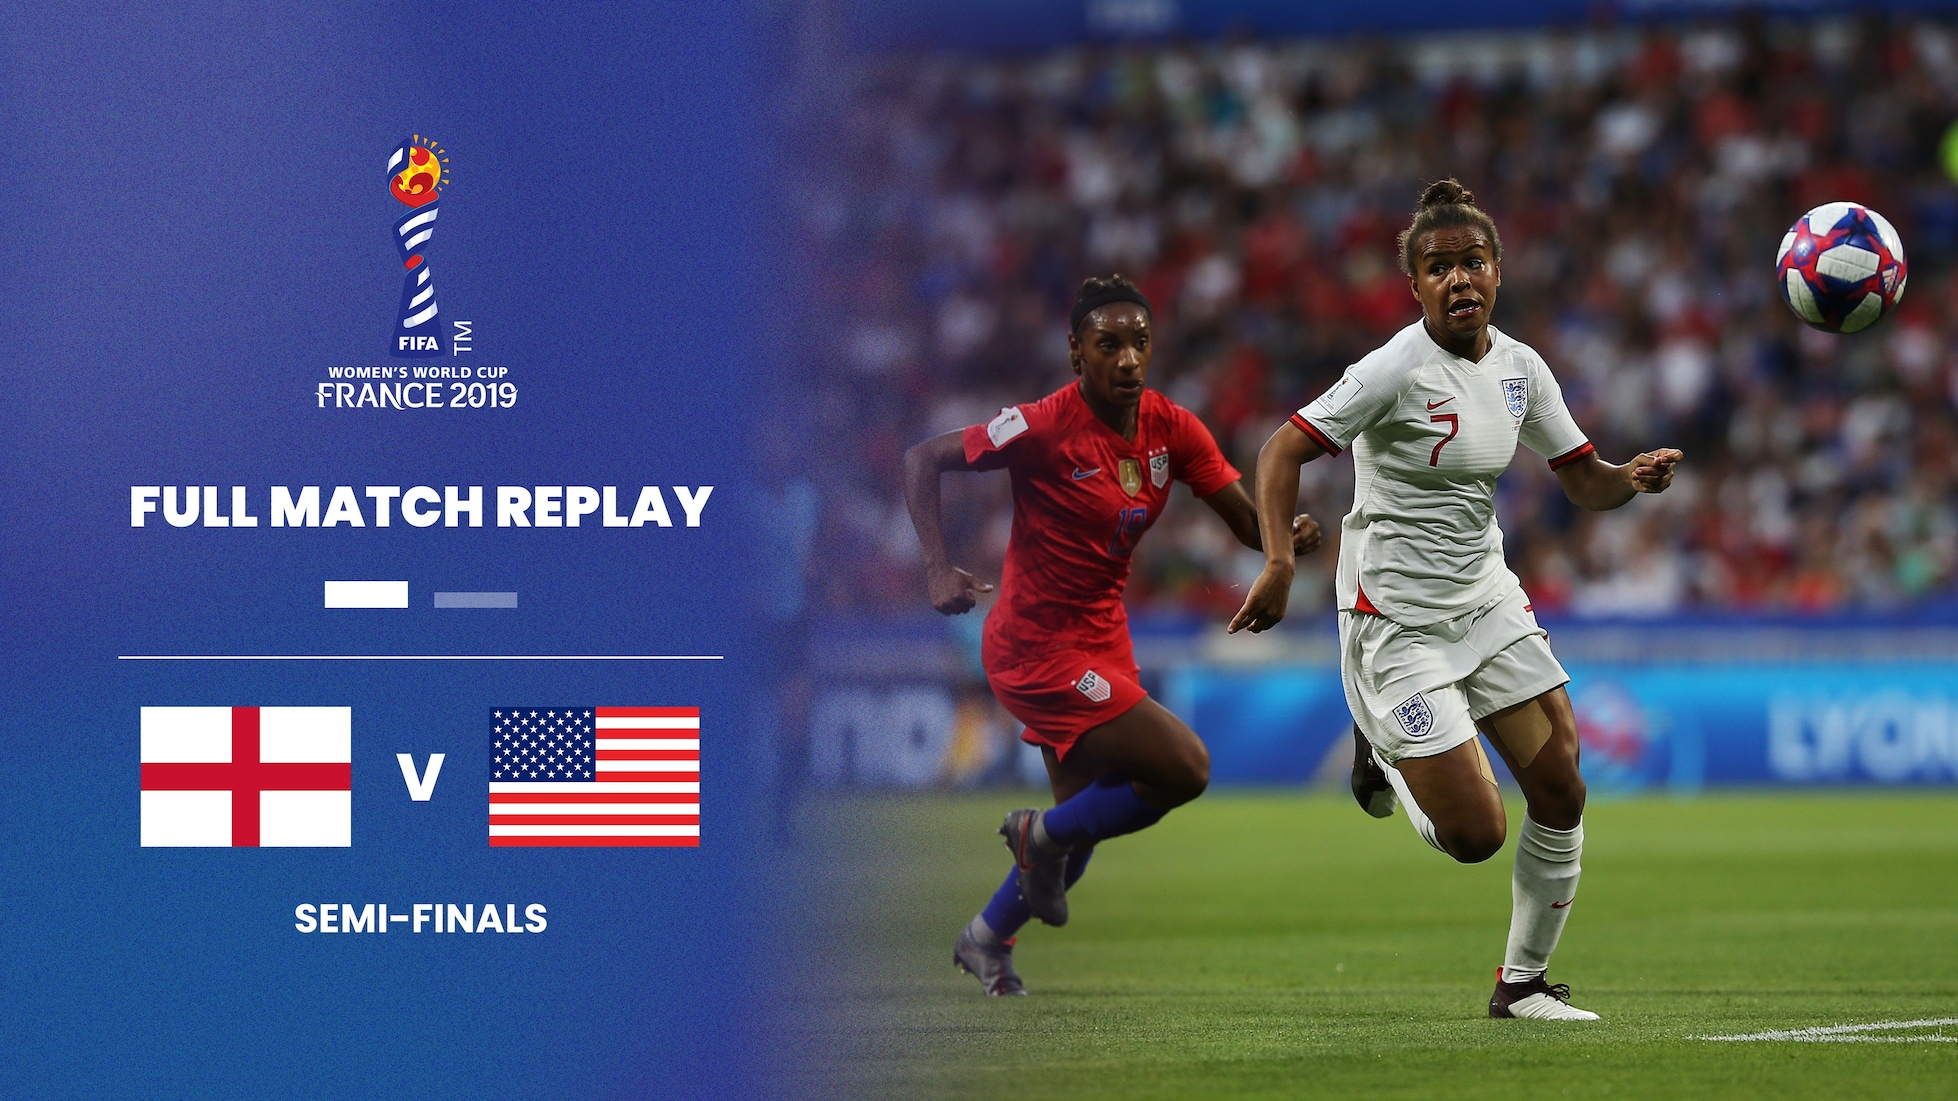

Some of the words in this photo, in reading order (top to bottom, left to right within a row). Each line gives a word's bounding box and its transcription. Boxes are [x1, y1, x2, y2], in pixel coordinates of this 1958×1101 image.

[1429, 413, 1459, 467] 7
[1151, 456, 1167, 471] USA
[1108, 507, 1147, 556] 19
[1078, 672, 1095, 691] USA
